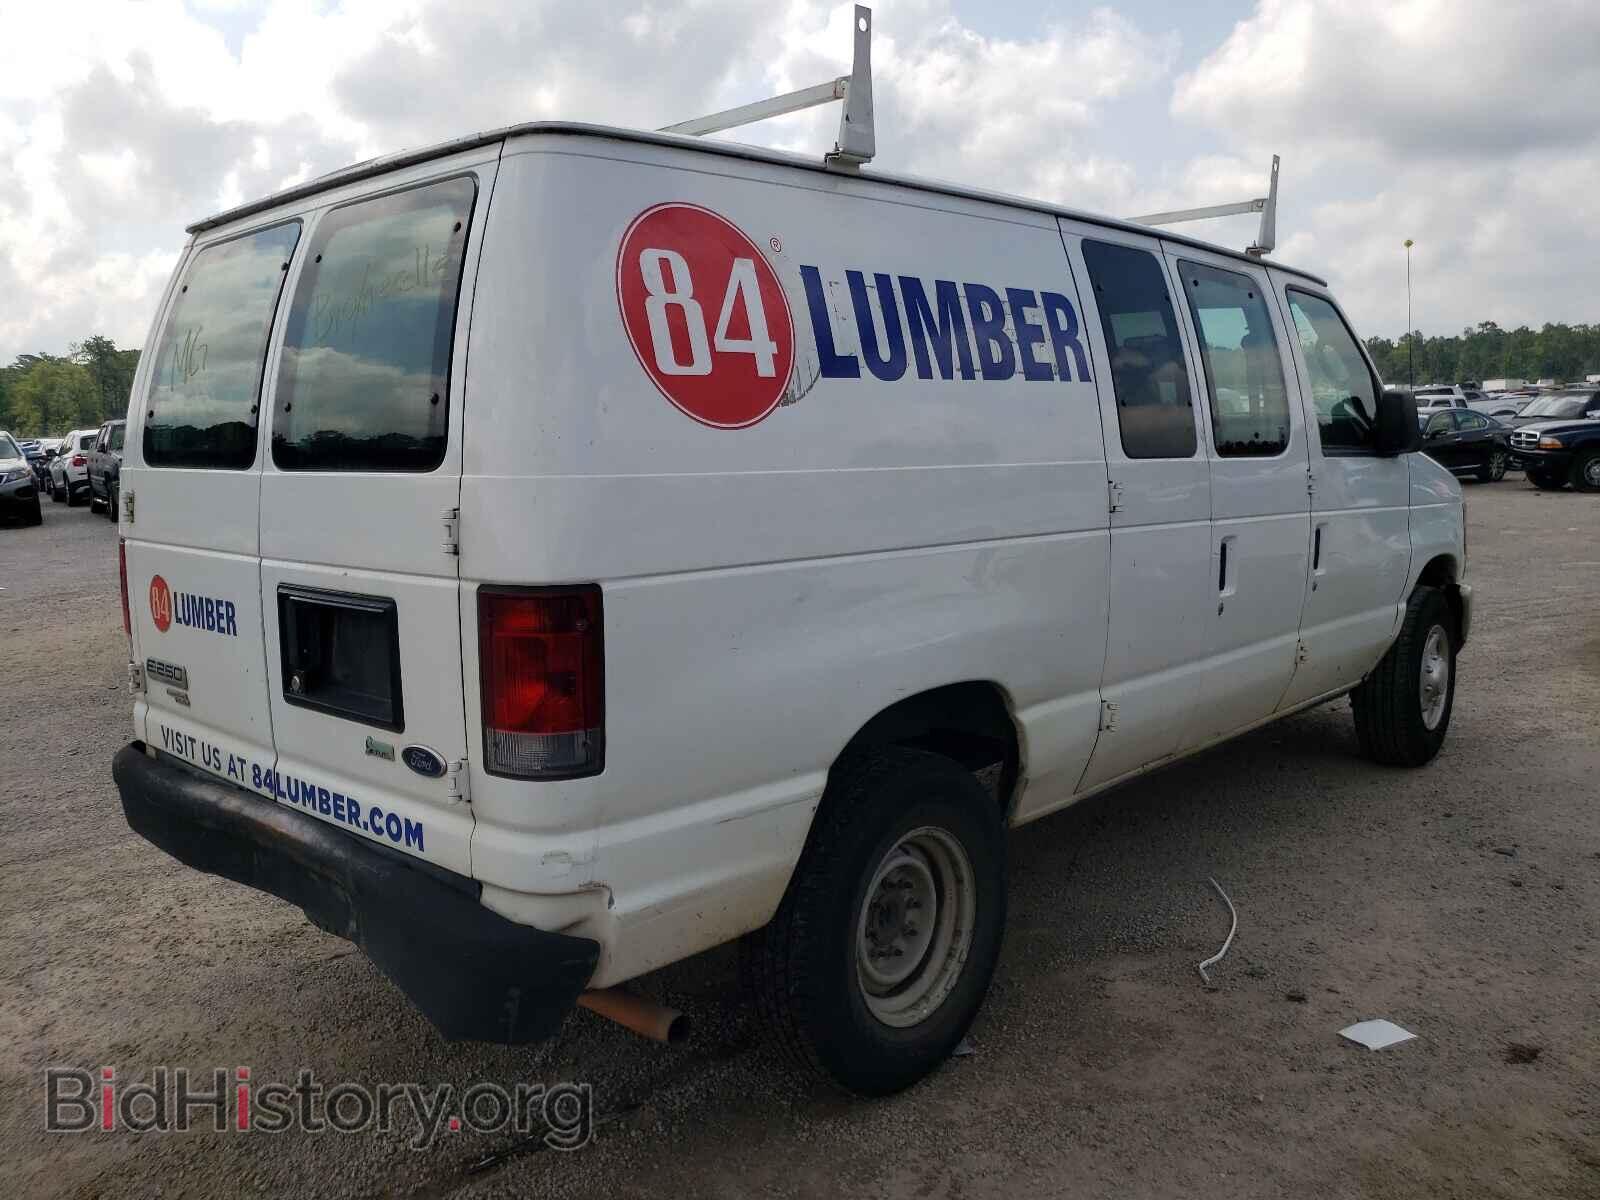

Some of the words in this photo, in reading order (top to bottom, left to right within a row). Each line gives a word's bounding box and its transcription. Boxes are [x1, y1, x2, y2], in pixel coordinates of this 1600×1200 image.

[639, 247, 778, 378] 84
[800, 264, 1092, 383] LUMBER
[151, 585, 171, 623] 84
[173, 591, 238, 637] LUMBER
[160, 724, 197, 761] VISIT
[201, 741, 222, 772] US
[226, 753, 248, 783] AT
[252, 763, 425, 853] 84LUMBER.COM
[410, 750, 434, 771] Ford
